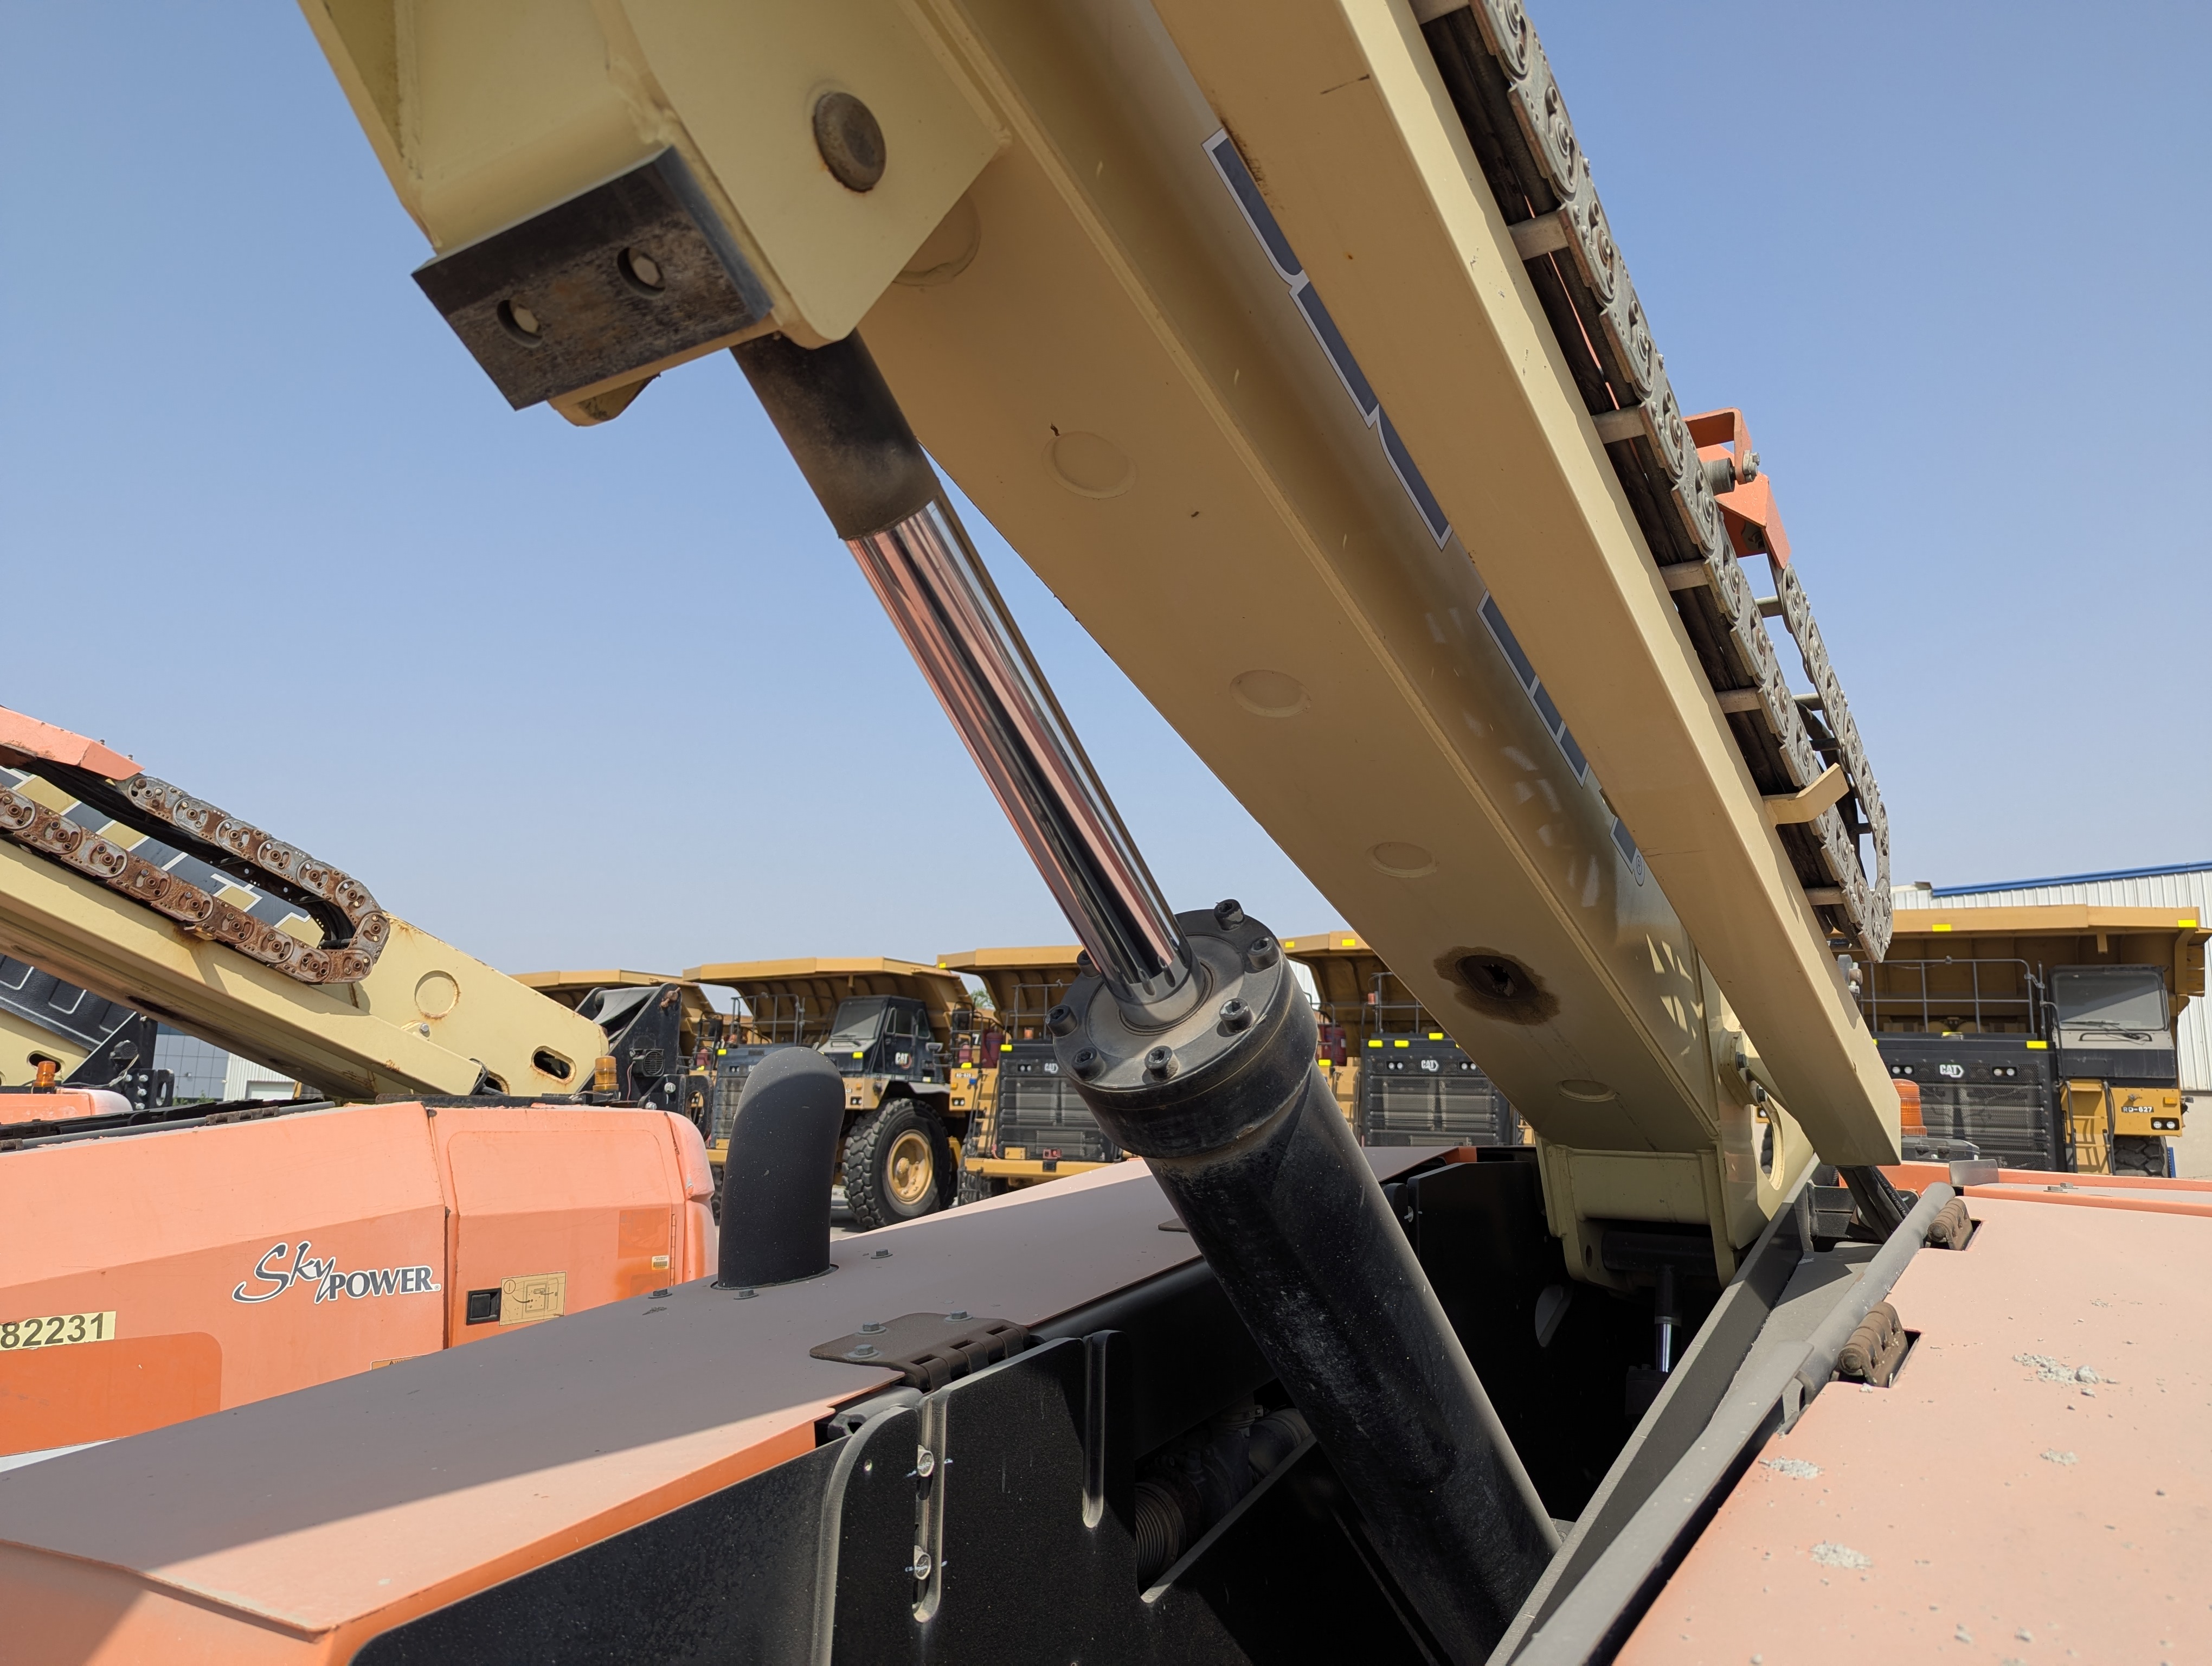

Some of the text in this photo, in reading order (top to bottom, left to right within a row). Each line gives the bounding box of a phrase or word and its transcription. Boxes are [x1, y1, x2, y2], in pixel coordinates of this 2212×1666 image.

[895, 1051, 909, 1065] CAT
[1045, 1063, 1057, 1073] CAT
[1421, 1060, 1437, 1071] CAT
[1939, 1064, 1962, 1077] CAT
[1, 1312, 104, 1349] 82231
